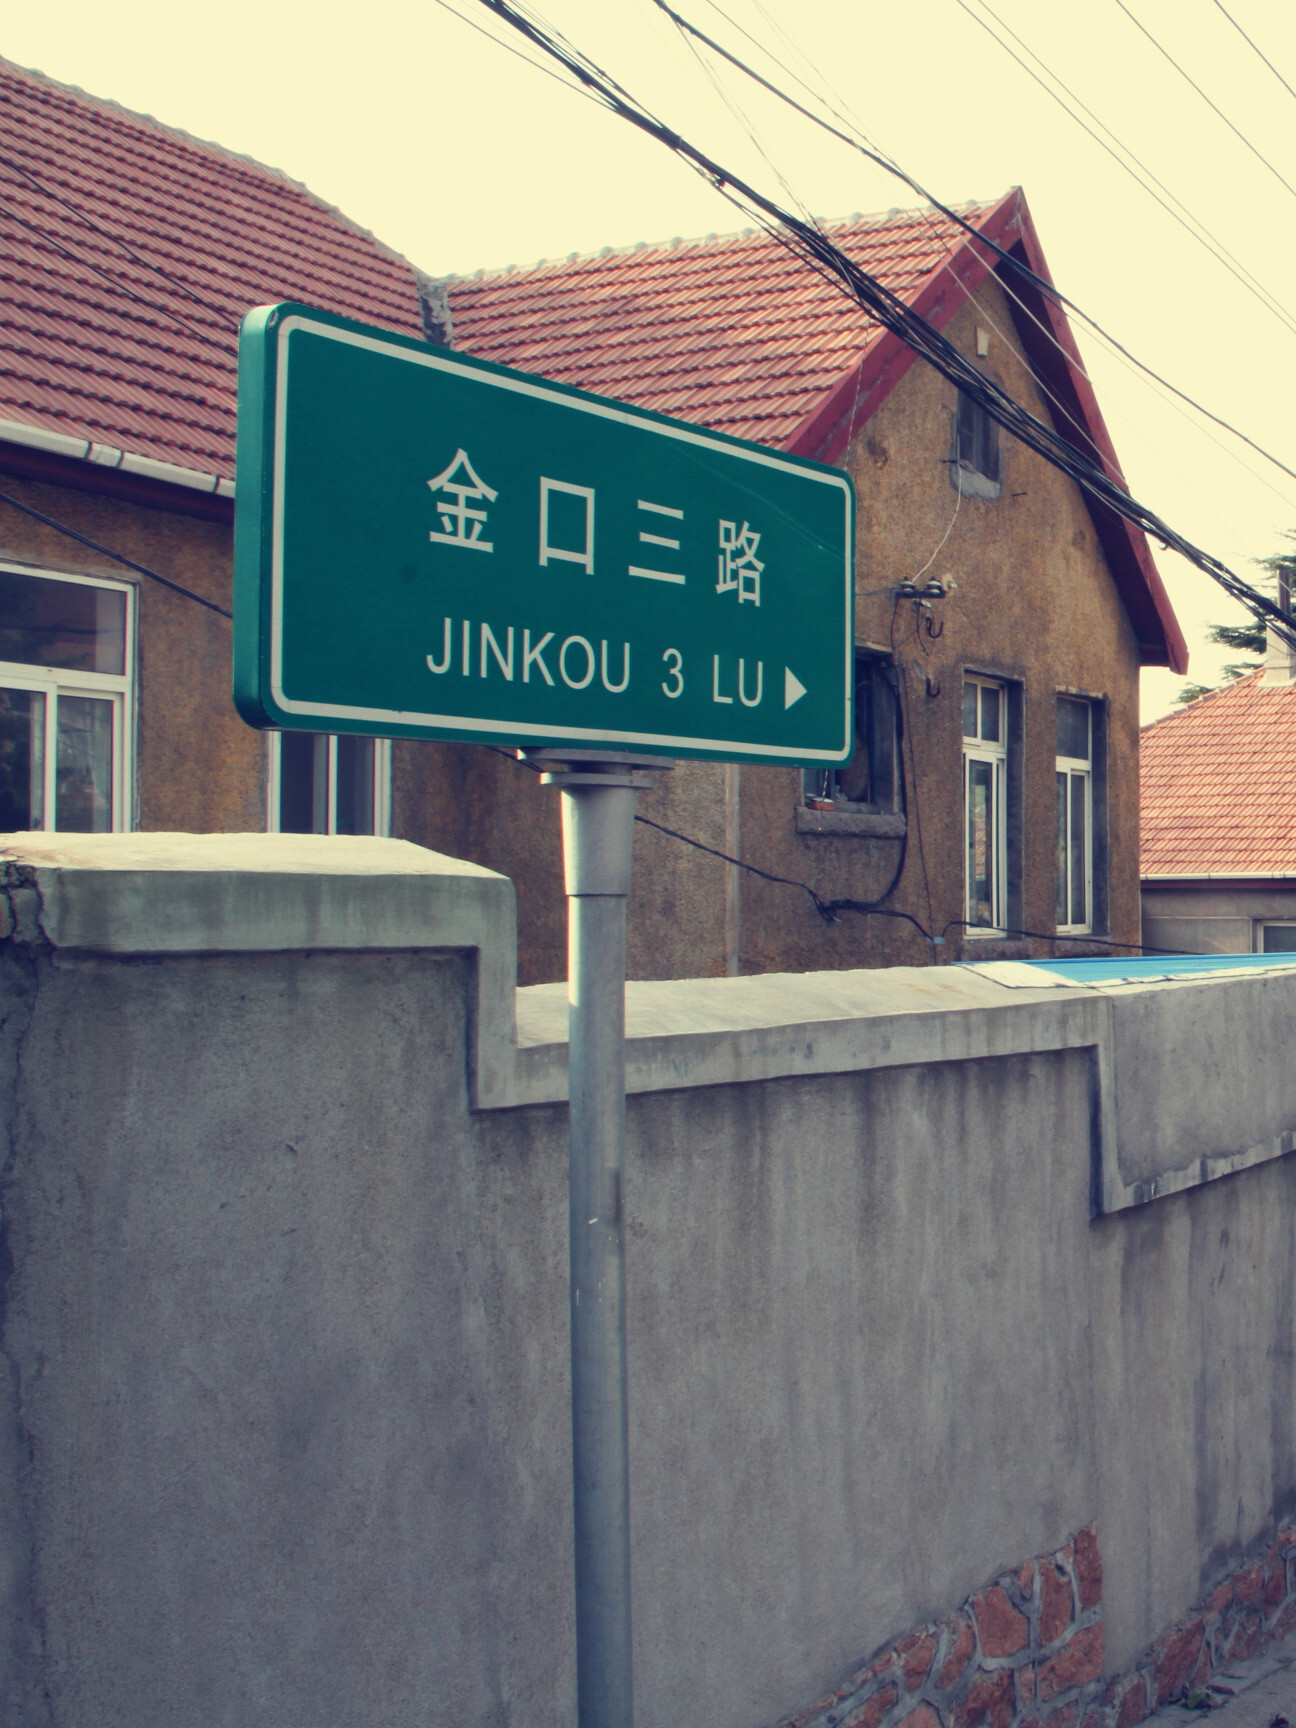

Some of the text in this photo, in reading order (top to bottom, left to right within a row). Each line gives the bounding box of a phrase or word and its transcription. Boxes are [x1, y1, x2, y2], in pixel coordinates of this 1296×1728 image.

[426, 447, 765, 607] 金口三路
[426, 617, 763, 708] JINKOU 3 LU
